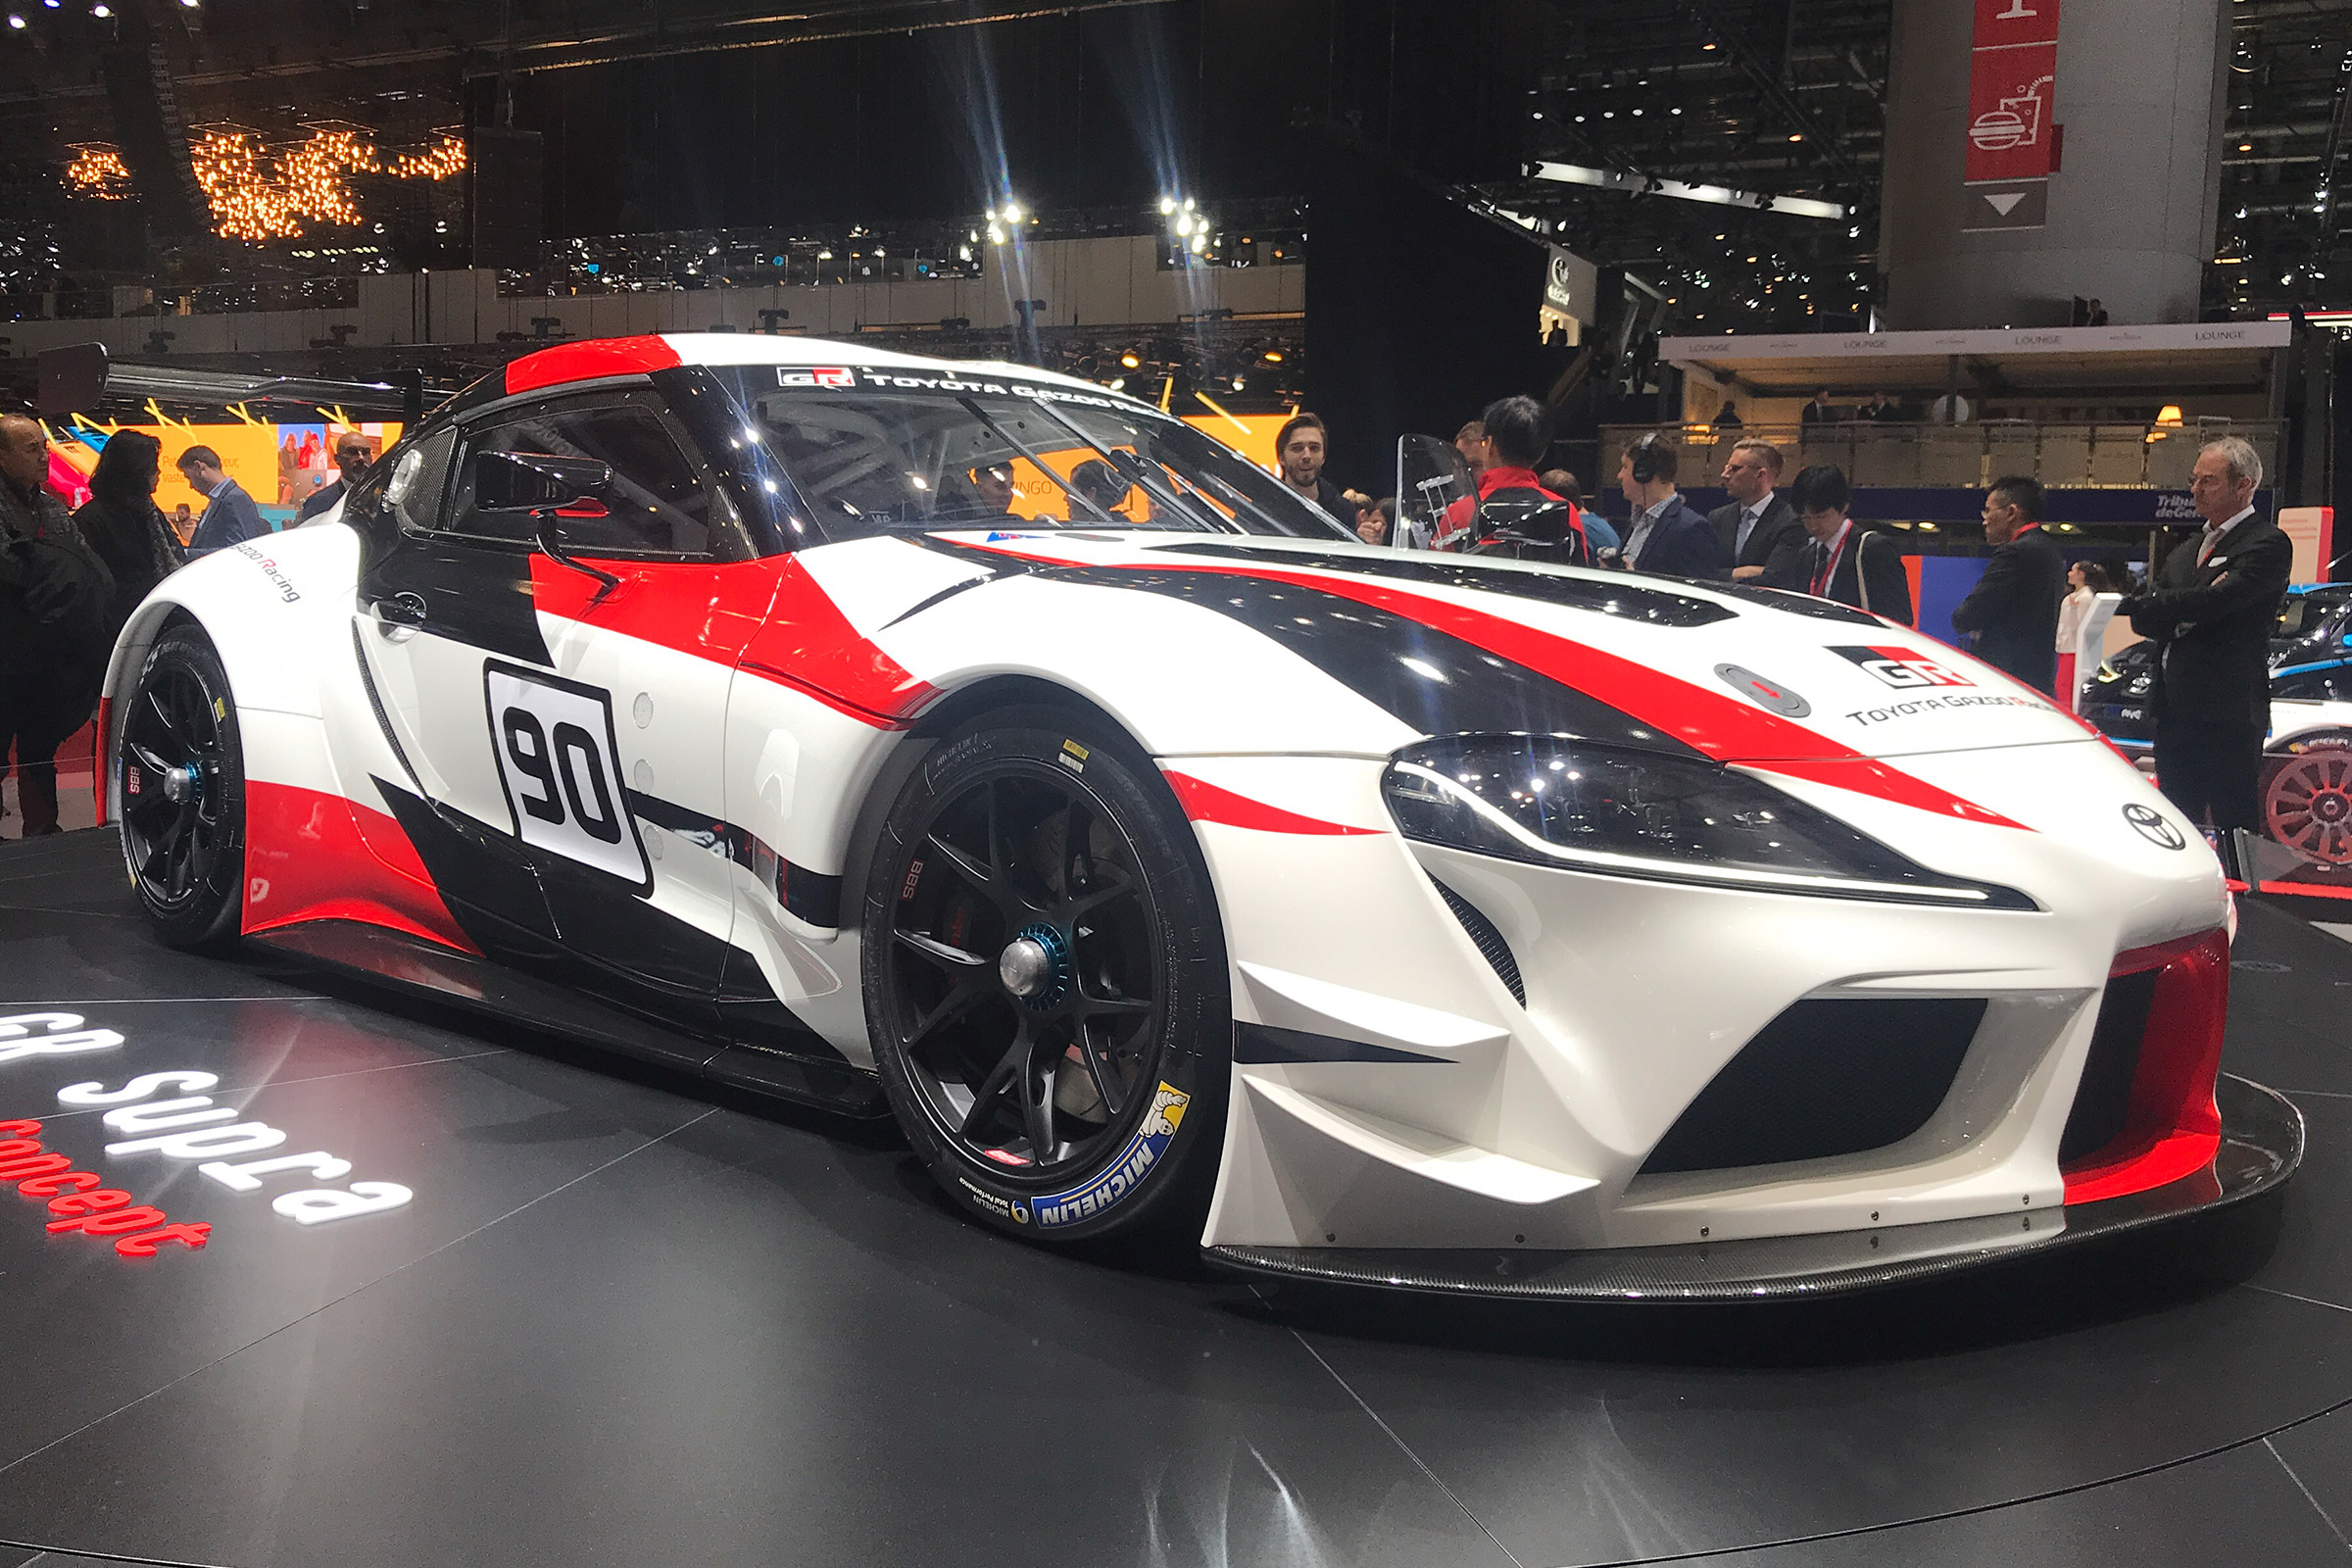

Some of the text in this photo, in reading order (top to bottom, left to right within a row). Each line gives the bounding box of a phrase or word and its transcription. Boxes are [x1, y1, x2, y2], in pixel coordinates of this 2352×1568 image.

[1689, 343, 1731, 353] LOUNGE
[1842, 339, 1887, 349] LOUNGE
[2014, 335, 2063, 345] LOUNGE
[2194, 329, 2245, 341] LOUNGE
[782, 373, 853, 385] GR
[862, 374, 1008, 394] TOYOTA
[257, 559, 301, 603] Racing
[1860, 660, 1972, 686] GR
[1844, 699, 1945, 726] TOYOTA
[129, 765, 141, 794] BBS
[502, 706, 622, 846] 90
[902, 861, 924, 900] BBS
[57, 1070, 414, 1226] Supra
[958, 1176, 995, 1202] Performance
[1042, 1142, 1155, 1225] MICHELIN
[972, 1194, 1010, 1218] MICHELIN
